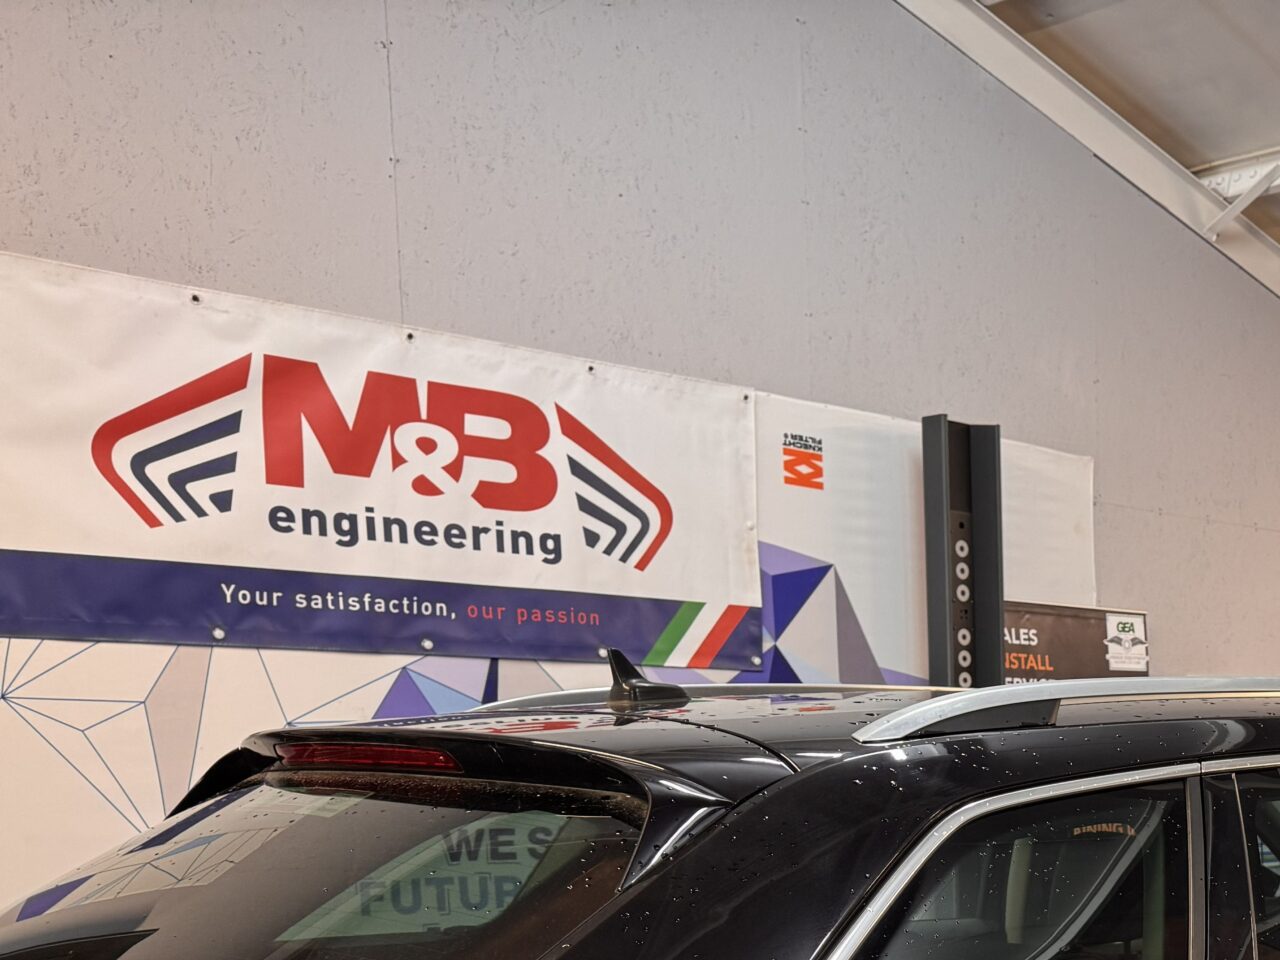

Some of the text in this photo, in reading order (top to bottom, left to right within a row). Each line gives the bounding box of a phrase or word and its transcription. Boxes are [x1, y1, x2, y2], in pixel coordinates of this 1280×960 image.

[262, 353, 559, 512] M&B
[268, 503, 562, 565] engineering
[220, 583, 600, 625] Your satisfaction, our passion
[1116, 621, 1135, 633] GEA
